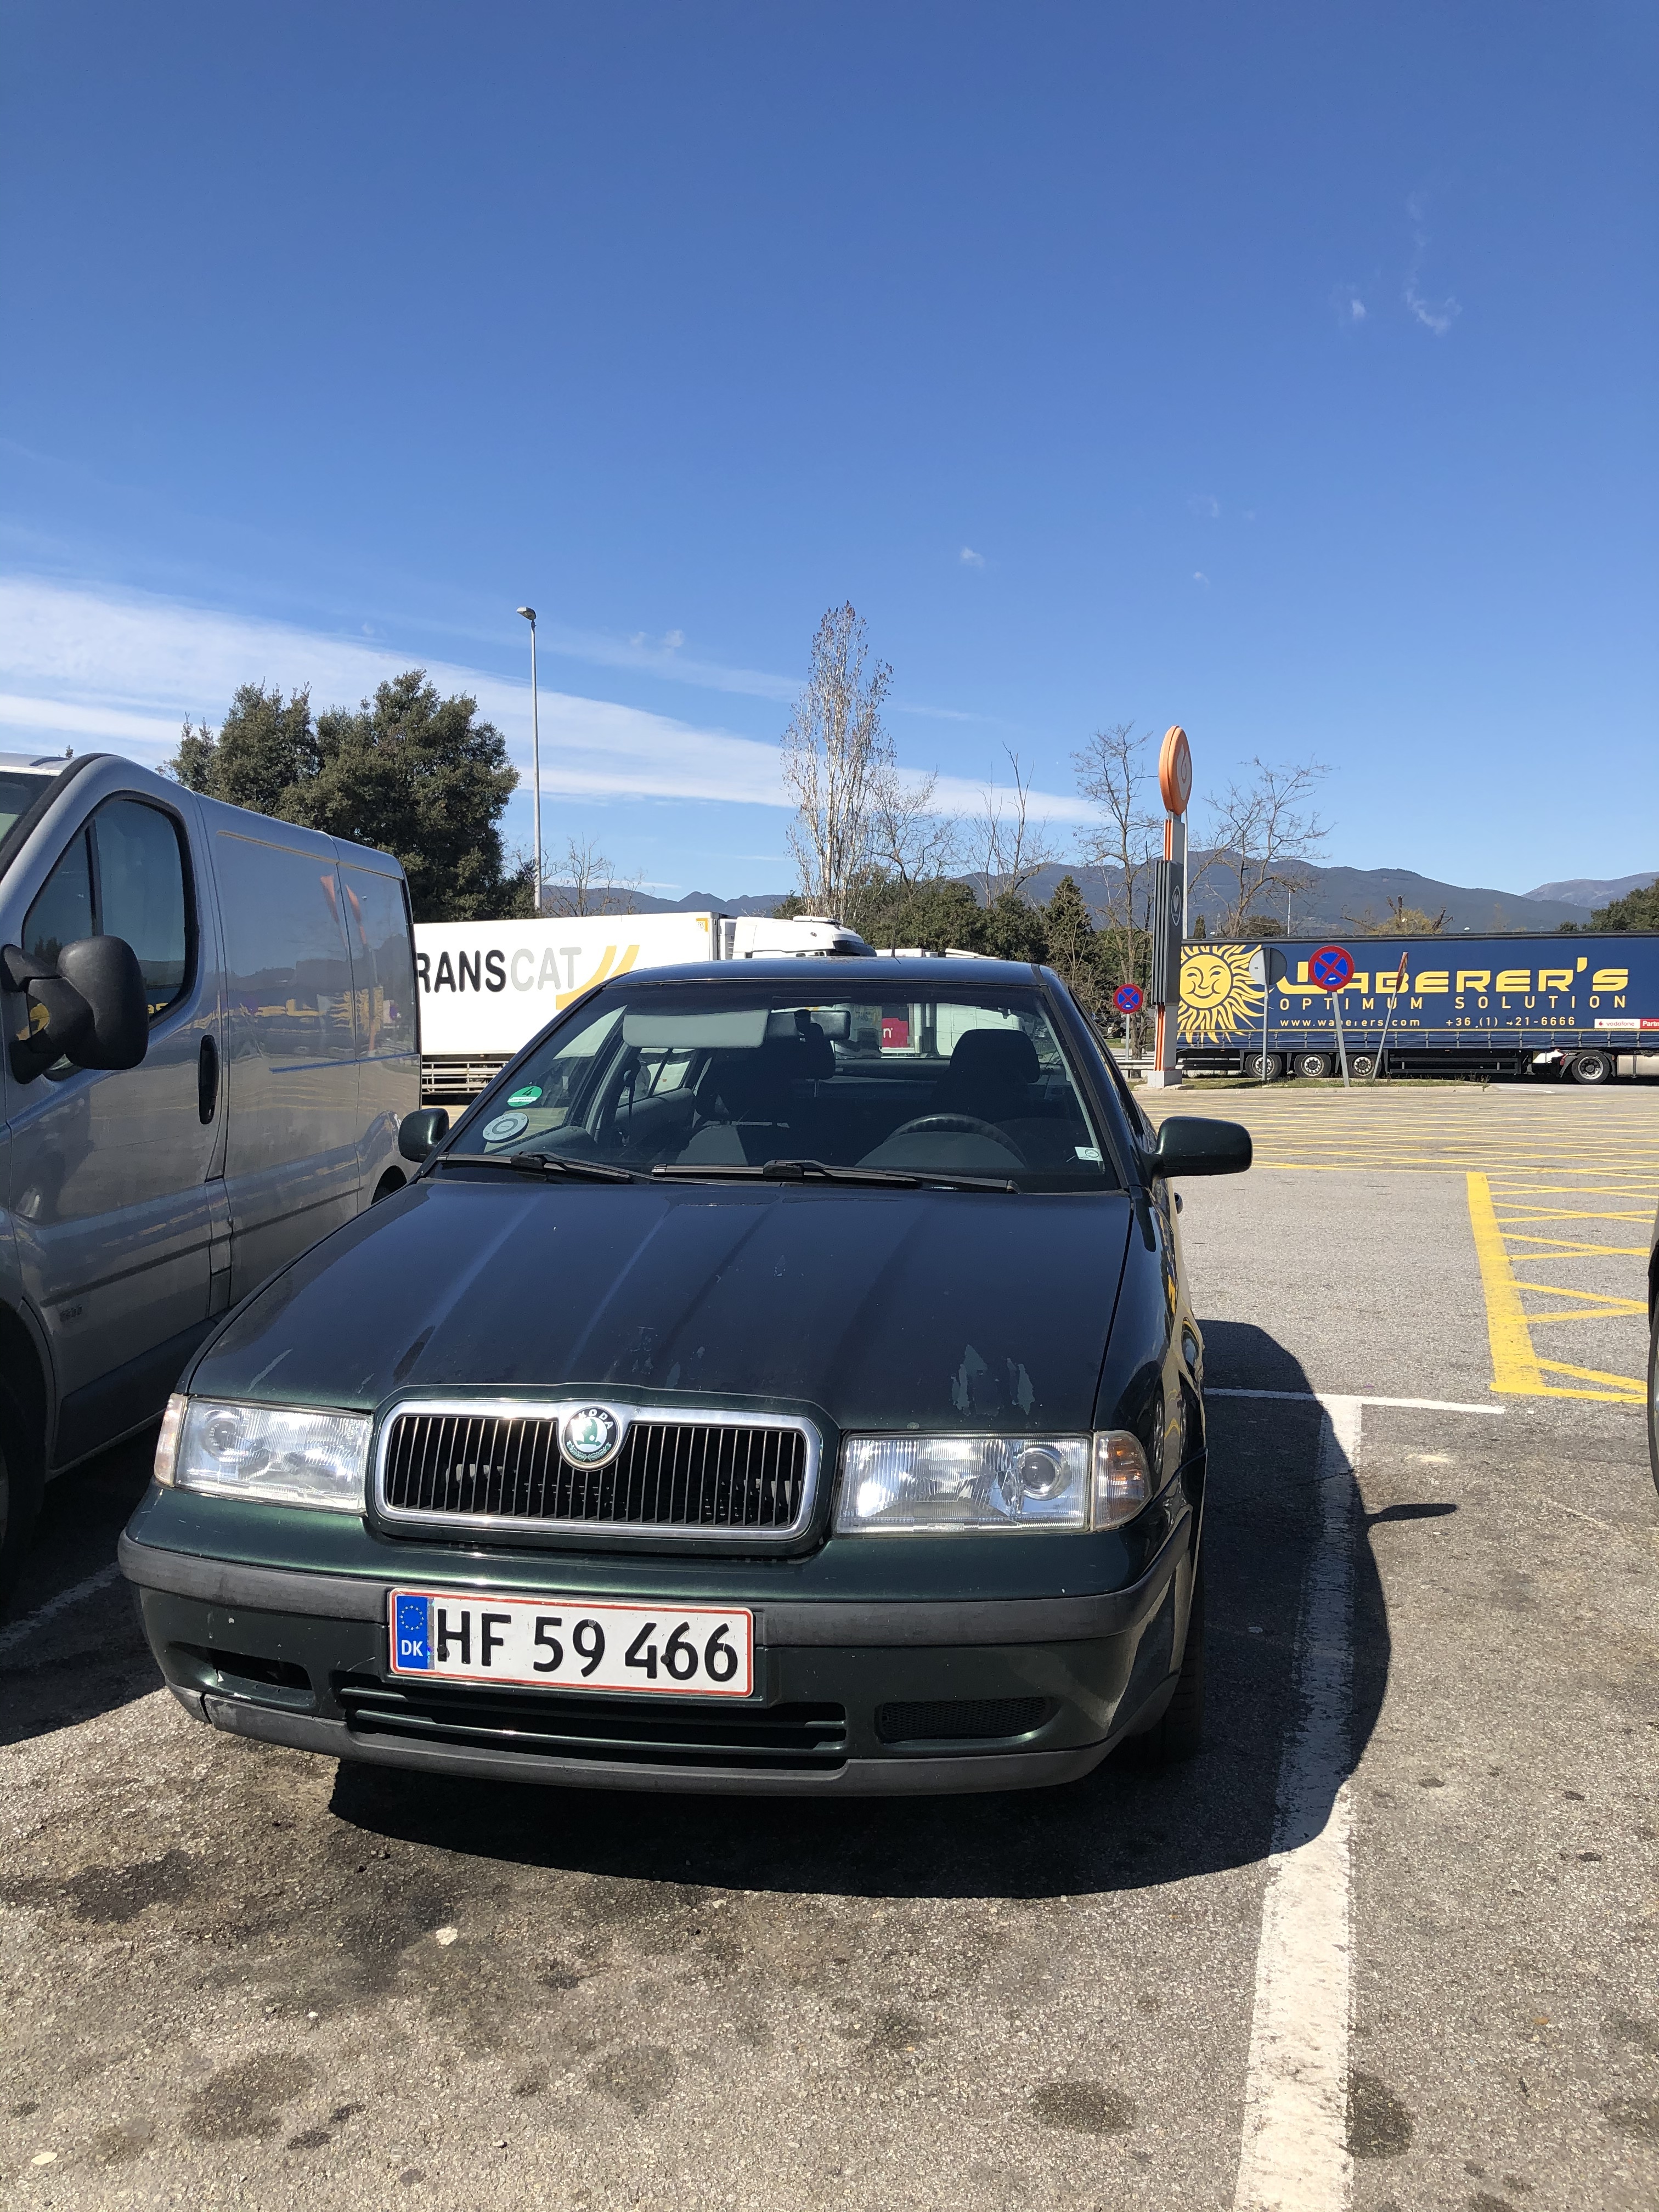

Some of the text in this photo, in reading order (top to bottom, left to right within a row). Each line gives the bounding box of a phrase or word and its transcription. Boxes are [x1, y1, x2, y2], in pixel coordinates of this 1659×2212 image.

[1280, 995, 1626, 1010] OPTIMUM SOLUTION
[1446, 1017, 1471, 1026] +36
[1480, 1017, 1498, 1027] (1)
[522, 1087, 534, 1096] 4
[571, 1409, 614, 1430] KODA
[401, 1639, 424, 1657] DK
[437, 1609, 738, 1682] HF 59 466
